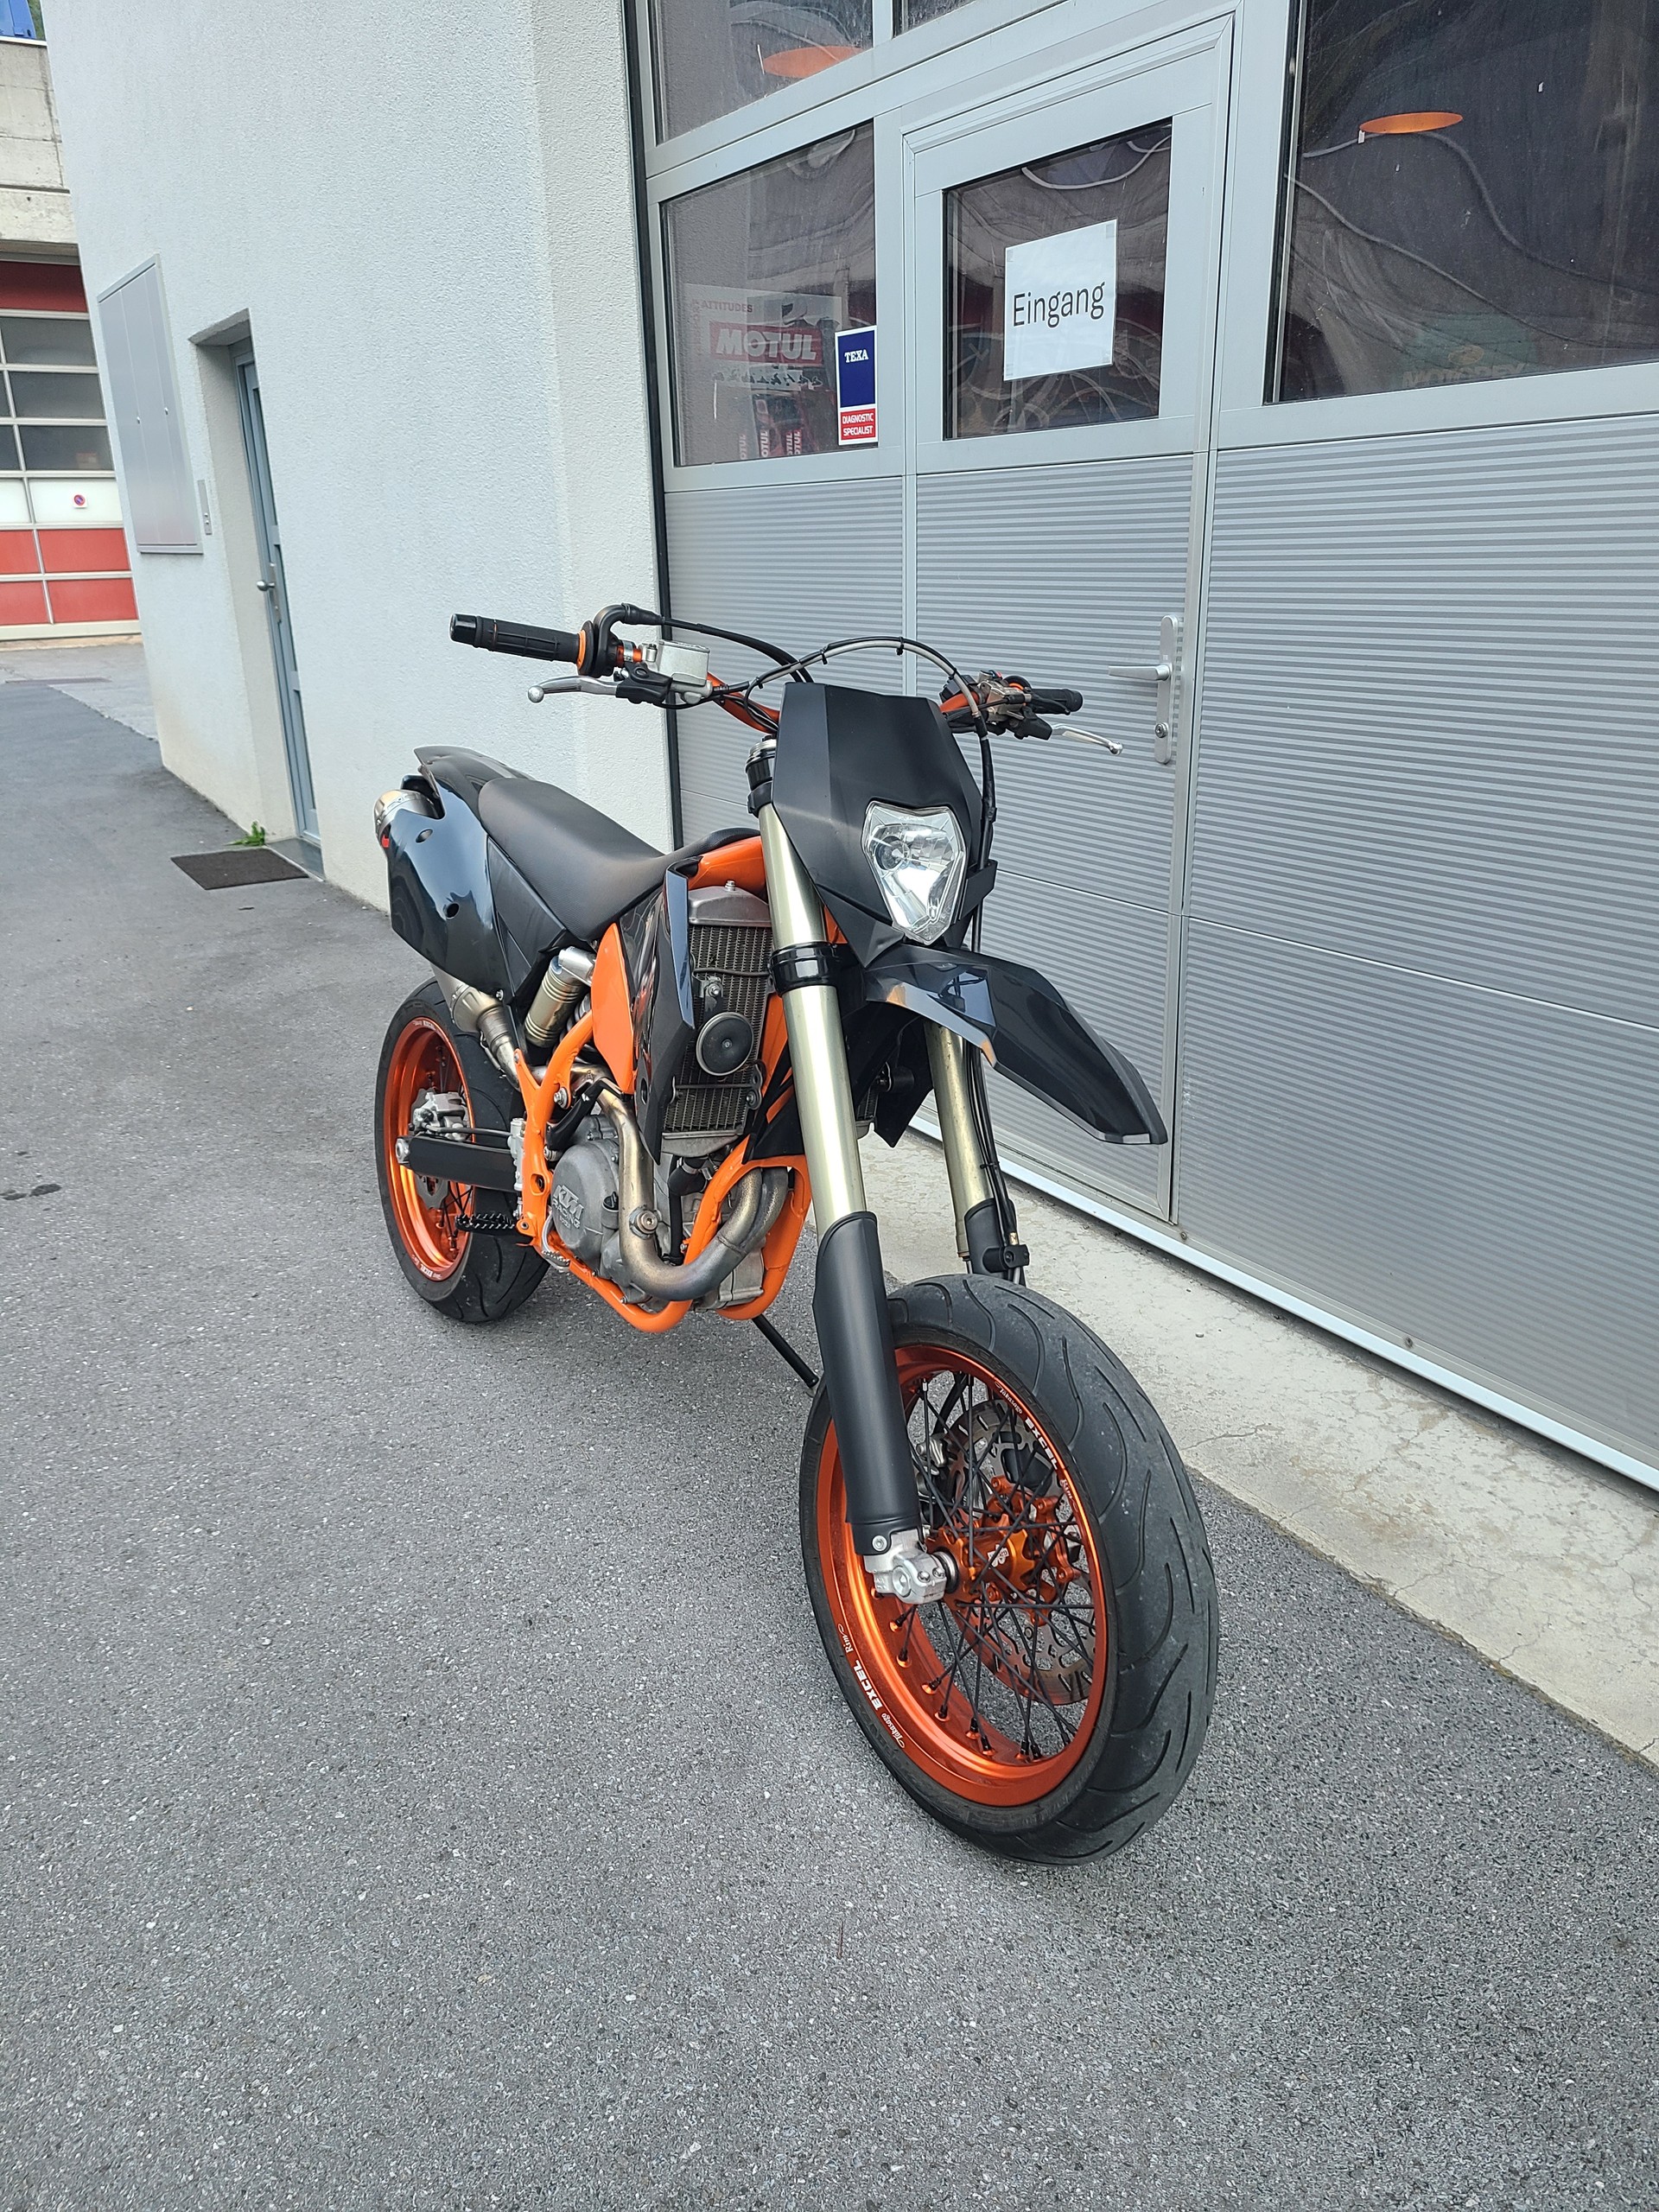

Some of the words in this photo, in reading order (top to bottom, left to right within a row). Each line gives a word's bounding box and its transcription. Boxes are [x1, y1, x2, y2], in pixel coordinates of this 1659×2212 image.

[702, 301, 753, 312] ATTITUDES
[1014, 282, 1105, 327] Eingang
[715, 328, 817, 360] MOTUL
[844, 349, 868, 363] TEXA
[842, 413, 874, 424] DIAGNOSTIC
[843, 426, 873, 436] SPECIALIST
[760, 430, 769, 458] OTUL
[553, 1185, 584, 1219] KTM
[995, 1382, 1023, 1414] Takasago
[1025, 1416, 1058, 1470] EXCEL
[853, 1659, 883, 1711] EXCEL
[881, 1713, 906, 1749] Takasago
